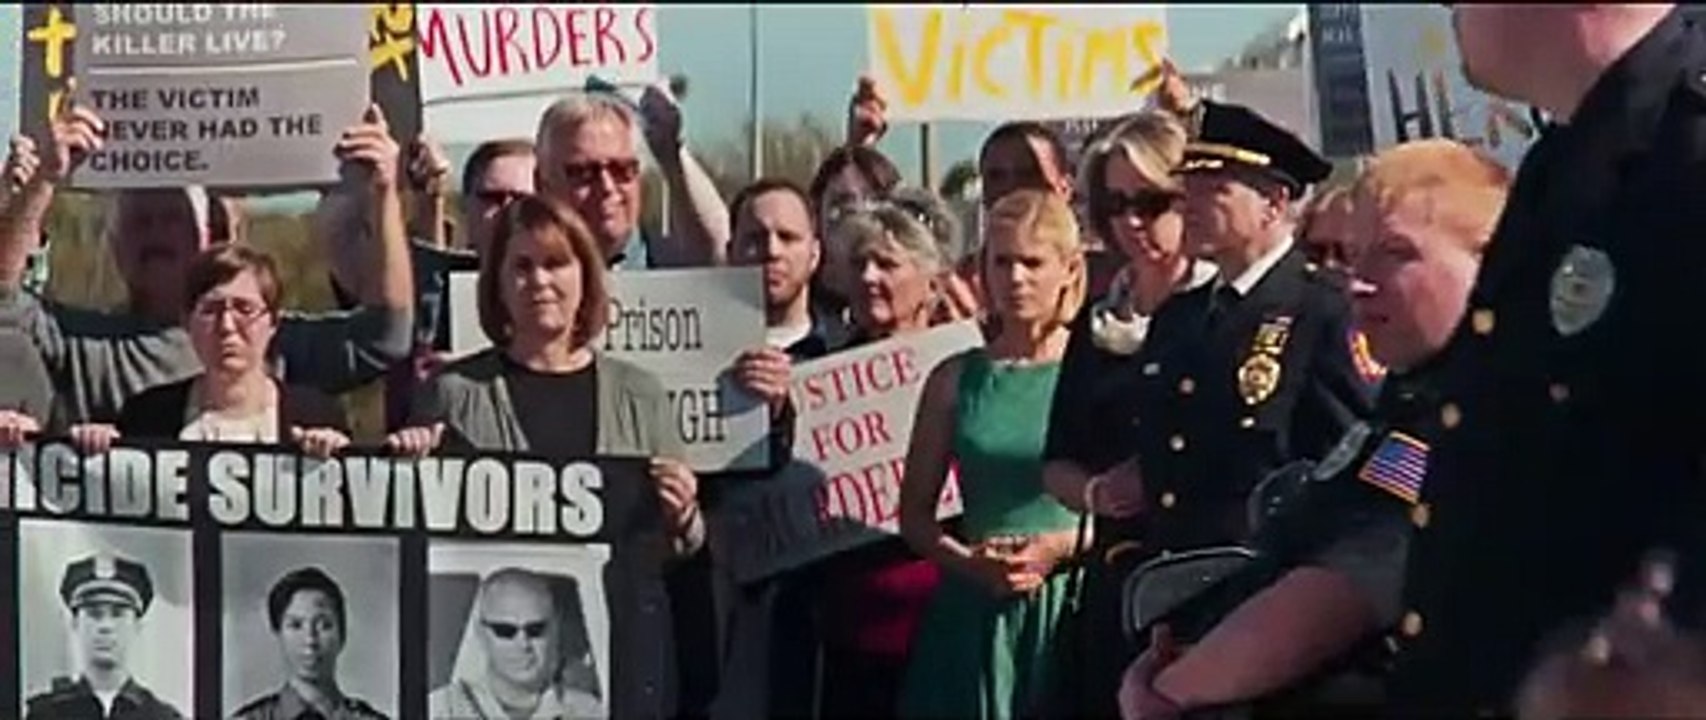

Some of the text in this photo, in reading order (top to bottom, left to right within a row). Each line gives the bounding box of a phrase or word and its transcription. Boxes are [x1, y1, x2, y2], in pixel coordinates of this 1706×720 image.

[92, 4, 277, 25] SHOULD THE
[91, 26, 287, 55] KILLER LIVE?
[418, 7, 654, 87] MURDERS
[90, 86, 261, 110] THE VICTIM
[197, 119, 259, 140] HAD
[269, 113, 323, 136] THE
[89, 149, 210, 173] CHOICE.
[603, 296, 703, 351] Prison
[803, 346, 921, 410] STICE
[810, 409, 891, 462] FOR
[0, 443, 604, 537] ICIDE SURVIVORS
